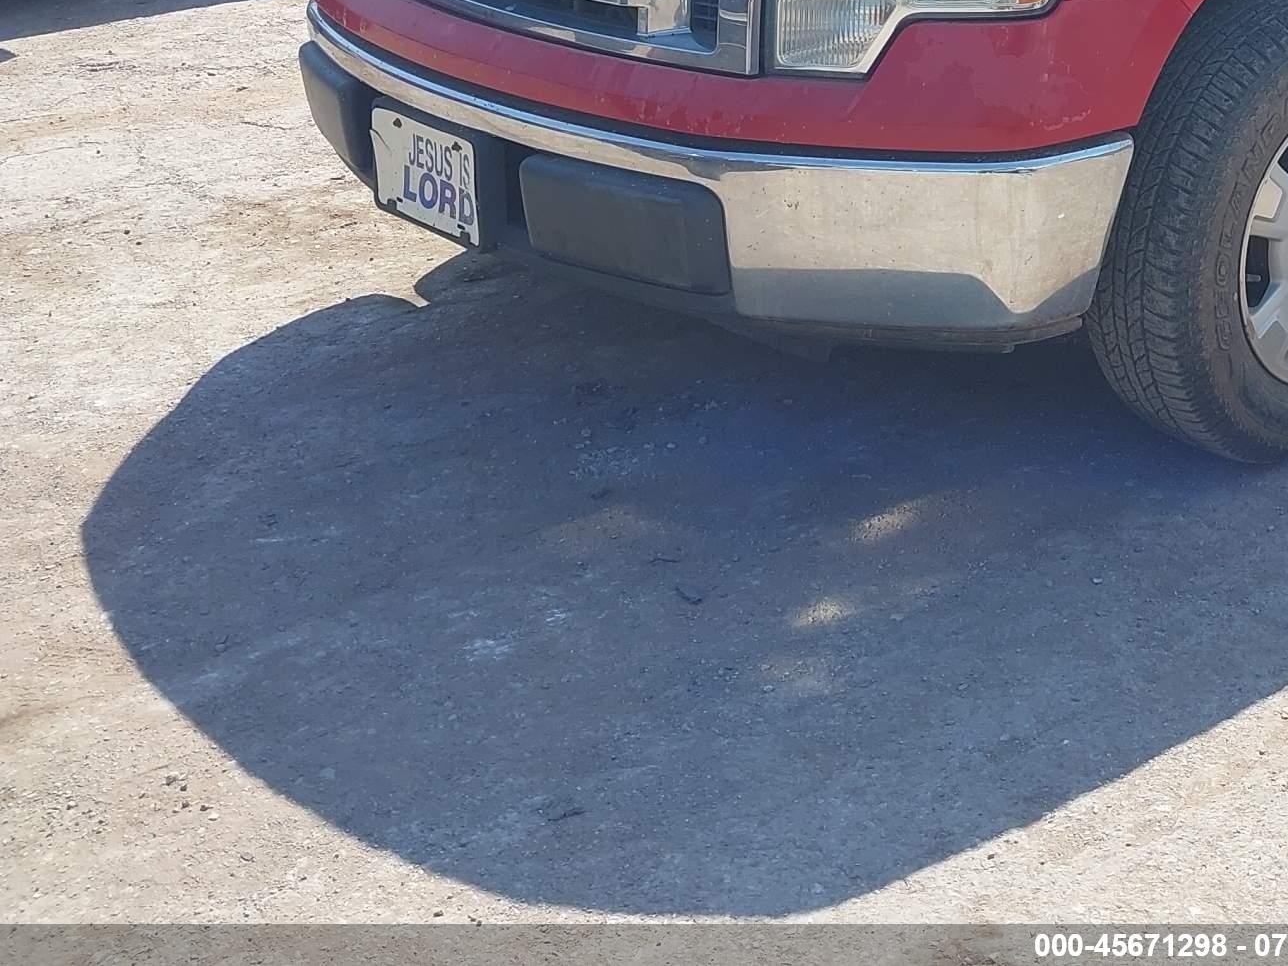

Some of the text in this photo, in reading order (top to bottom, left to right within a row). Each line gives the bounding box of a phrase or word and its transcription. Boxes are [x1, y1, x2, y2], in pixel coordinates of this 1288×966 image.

[408, 133, 471, 190] JESUS IS
[403, 164, 475, 226] LORD
